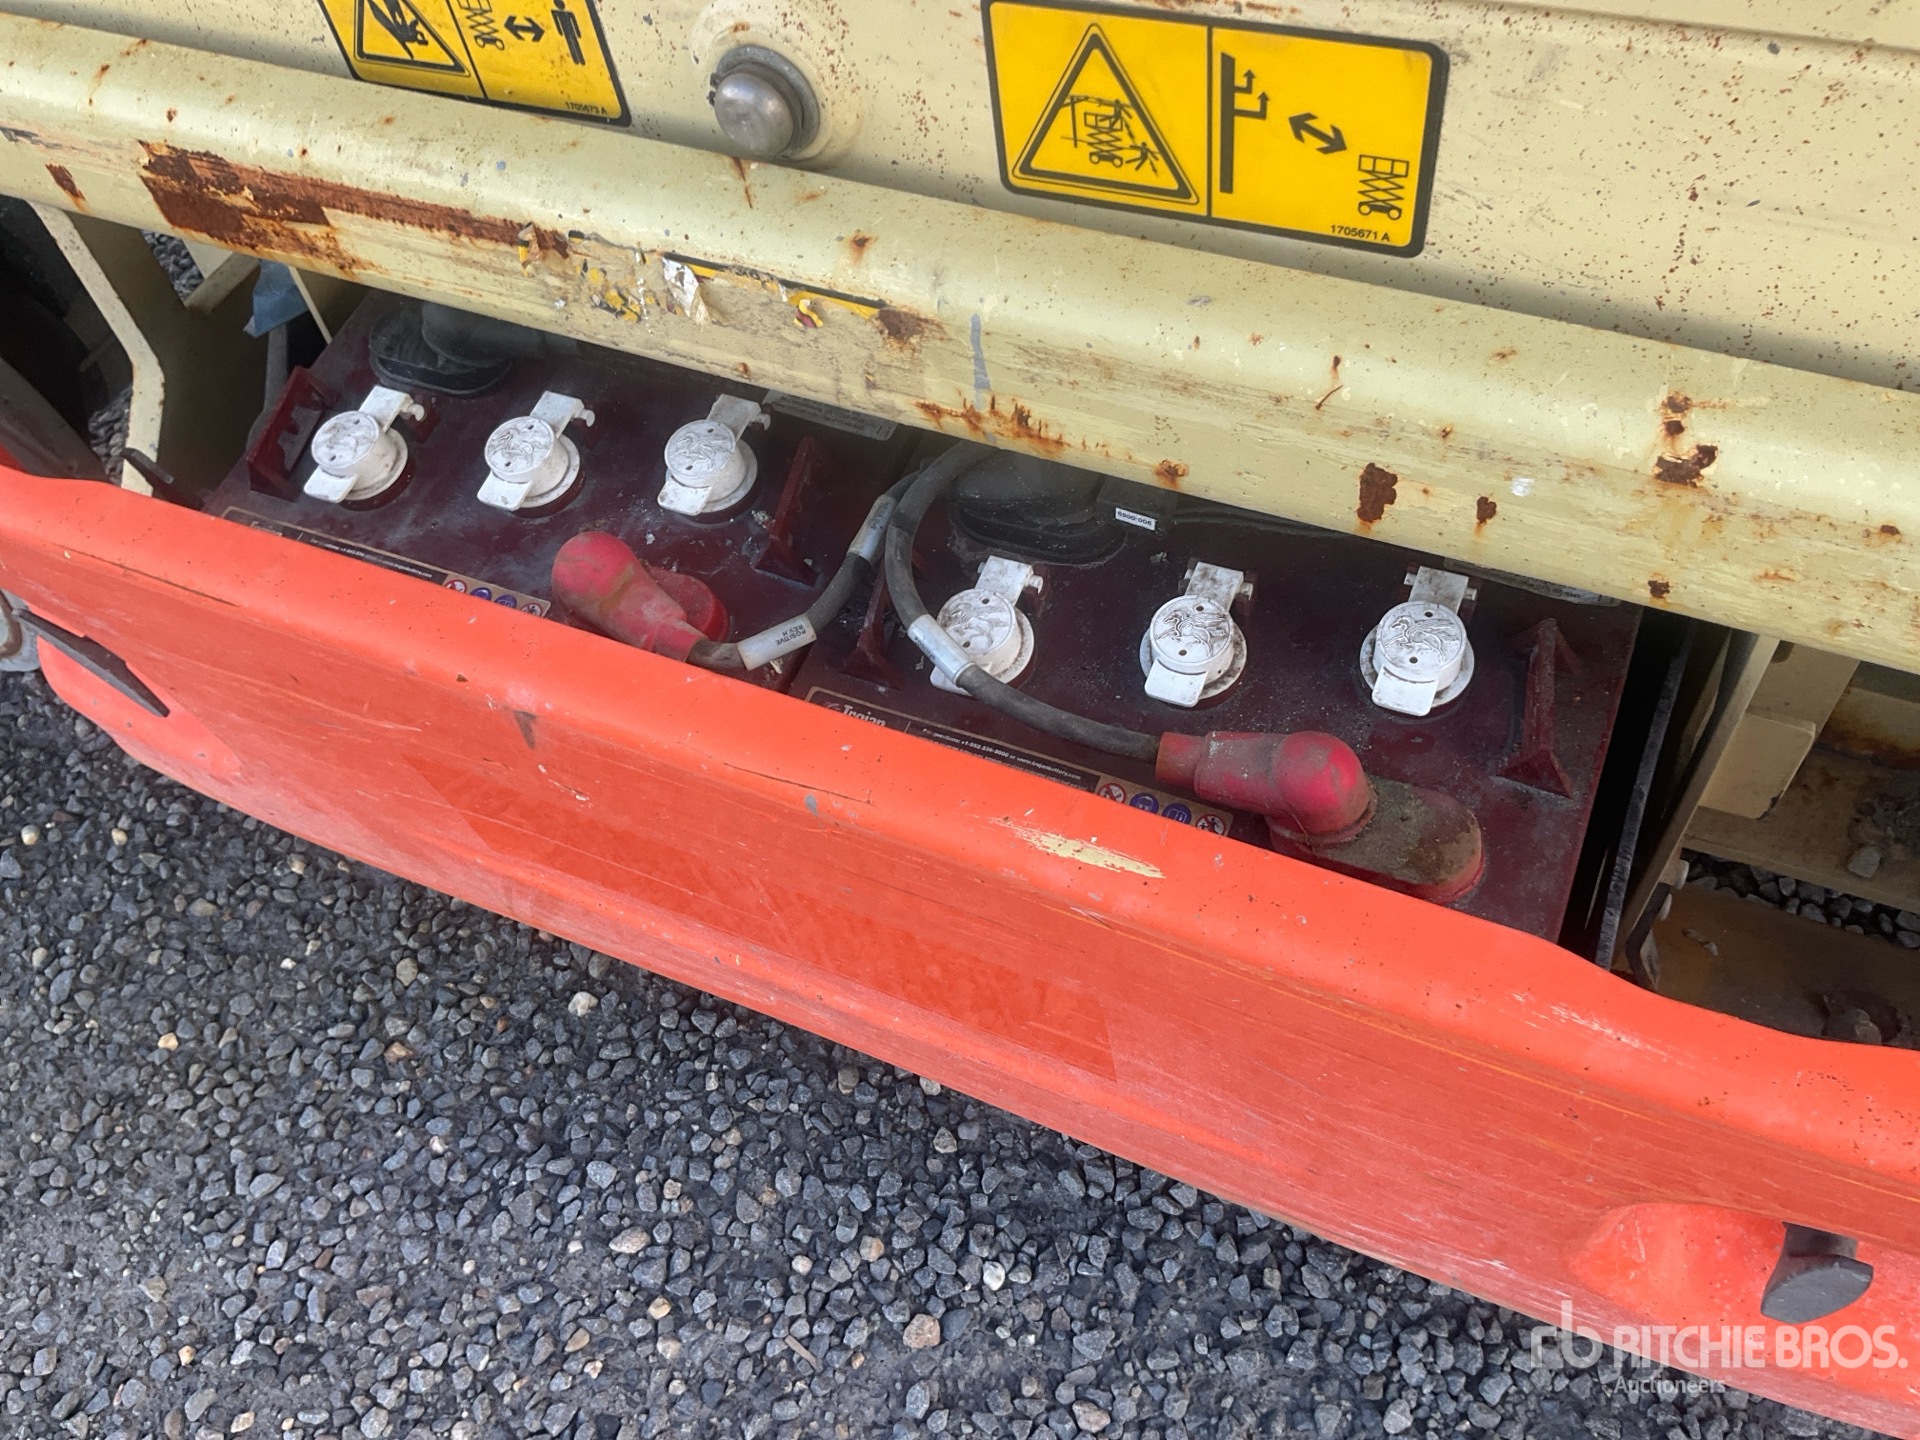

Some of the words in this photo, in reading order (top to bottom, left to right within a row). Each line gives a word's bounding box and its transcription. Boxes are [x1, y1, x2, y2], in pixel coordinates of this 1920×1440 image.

[565, 101, 599, 115] 1705673
[599, 107, 608, 116] A
[1330, 224, 1378, 240] 1705671
[1381, 232, 1391, 242] A
[775, 629, 807, 646] POSITIVE
